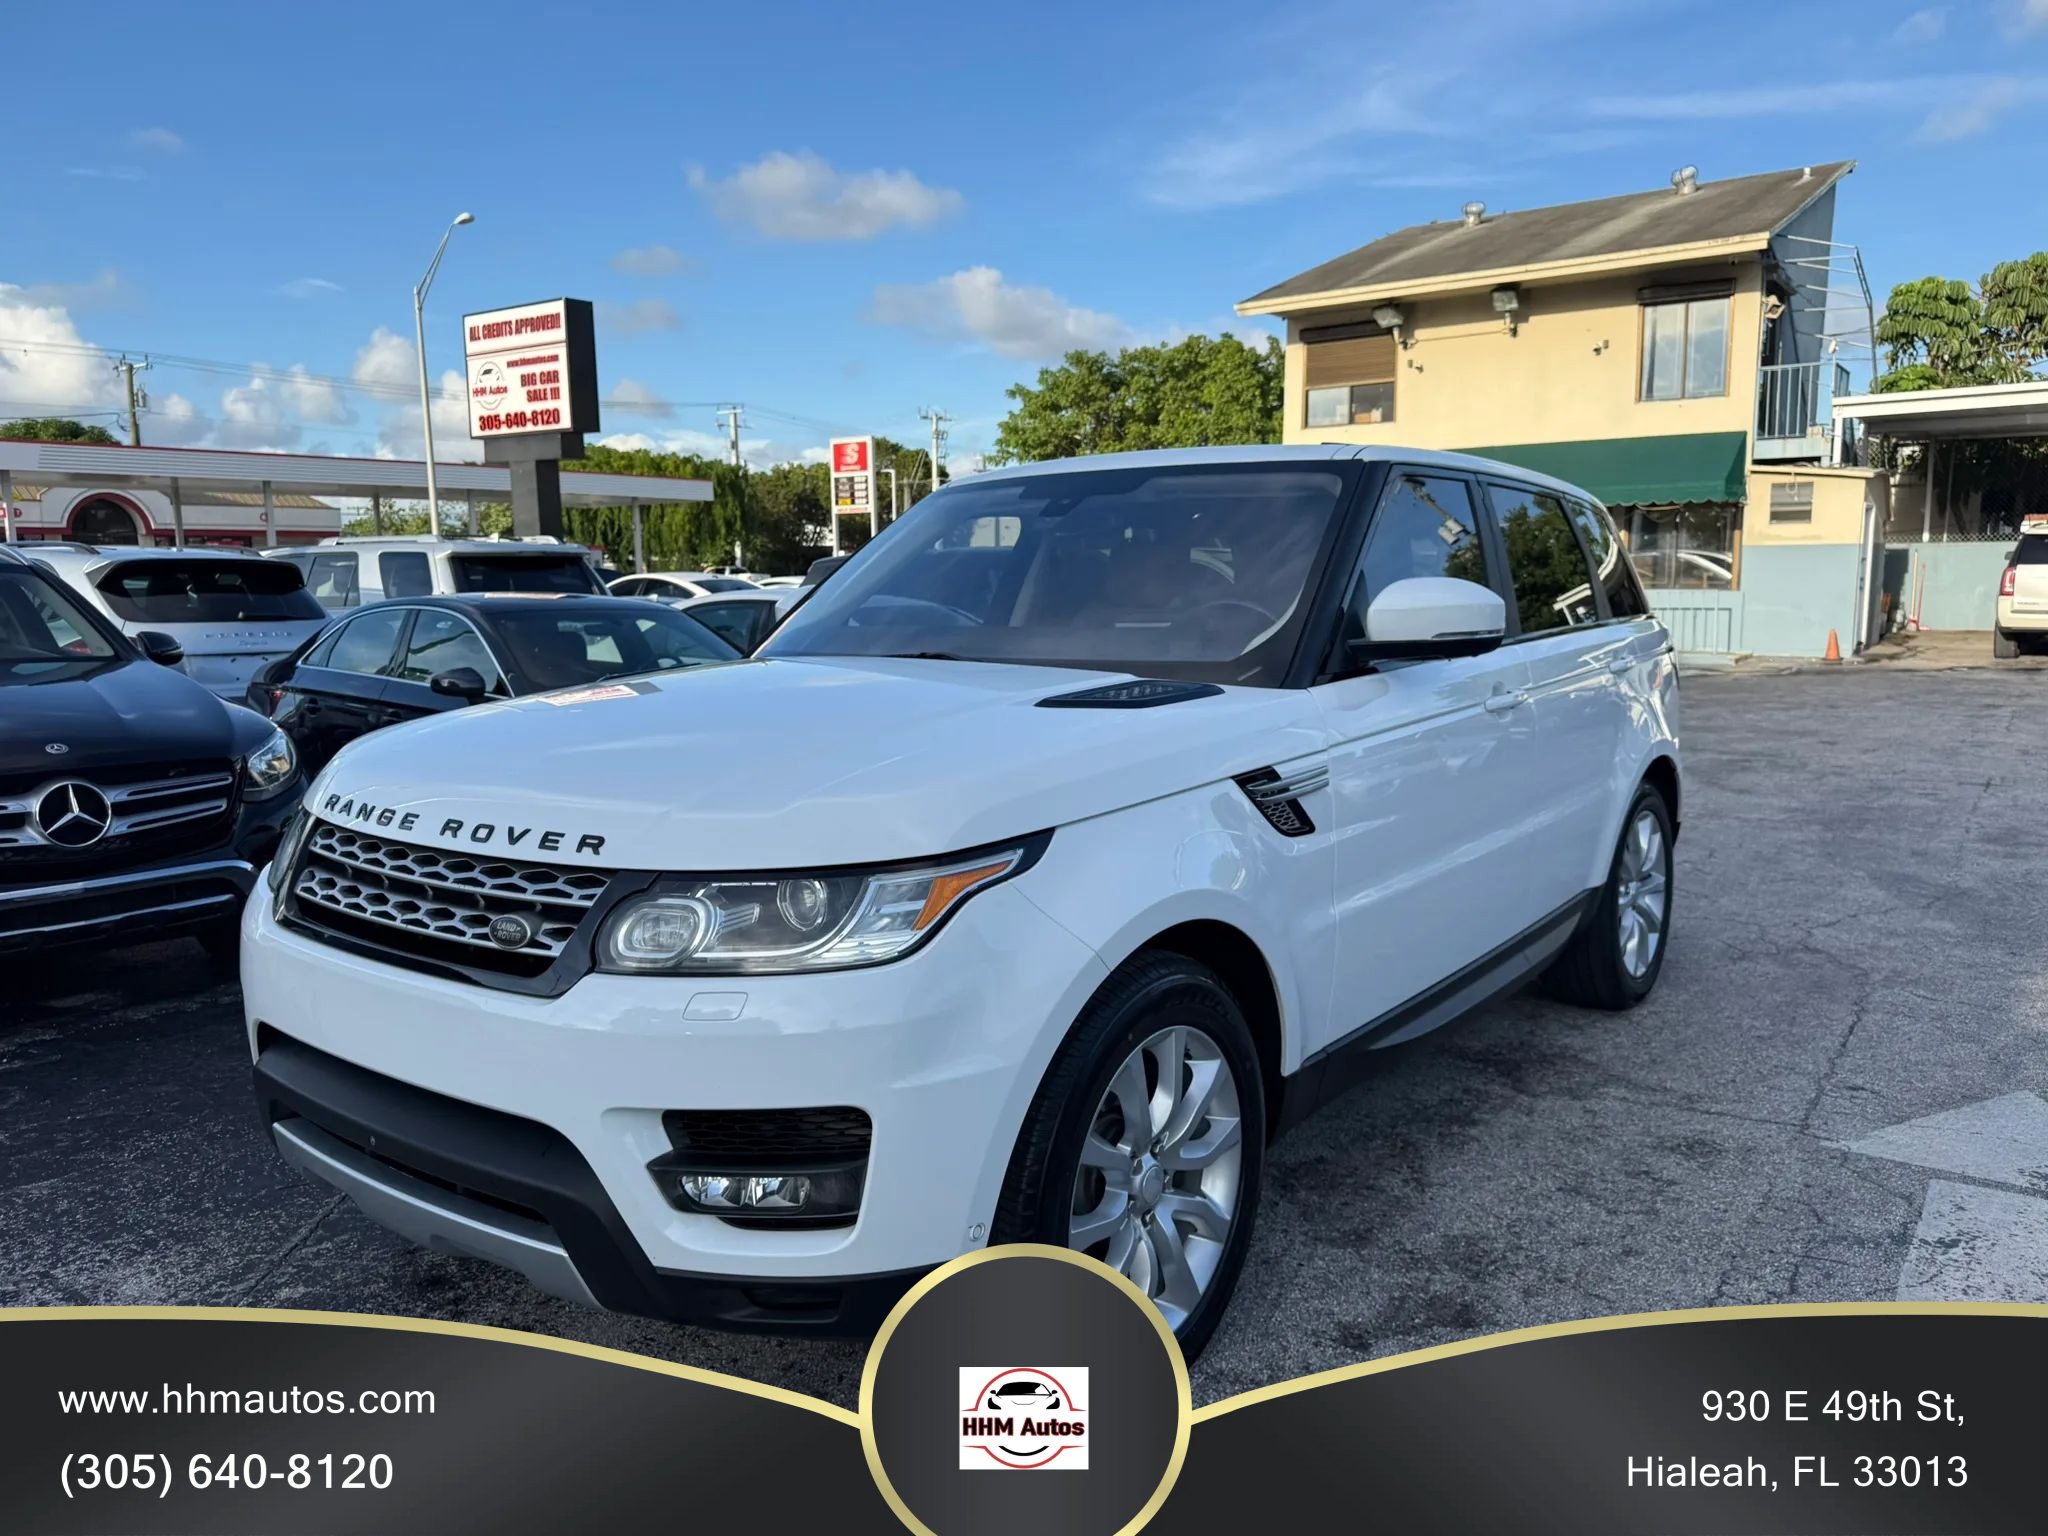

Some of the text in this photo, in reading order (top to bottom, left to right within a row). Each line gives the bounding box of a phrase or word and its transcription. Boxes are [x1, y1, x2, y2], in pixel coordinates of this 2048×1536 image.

[469, 326, 481, 342] ALL
[482, 320, 513, 340] CREDITS
[520, 370, 560, 387] BIG CAR
[472, 385, 508, 398] HHM Autos
[526, 388, 548, 403] SALE
[479, 408, 560, 431] 305-640-8120
[324, 794, 606, 856] RANGE ROVER
